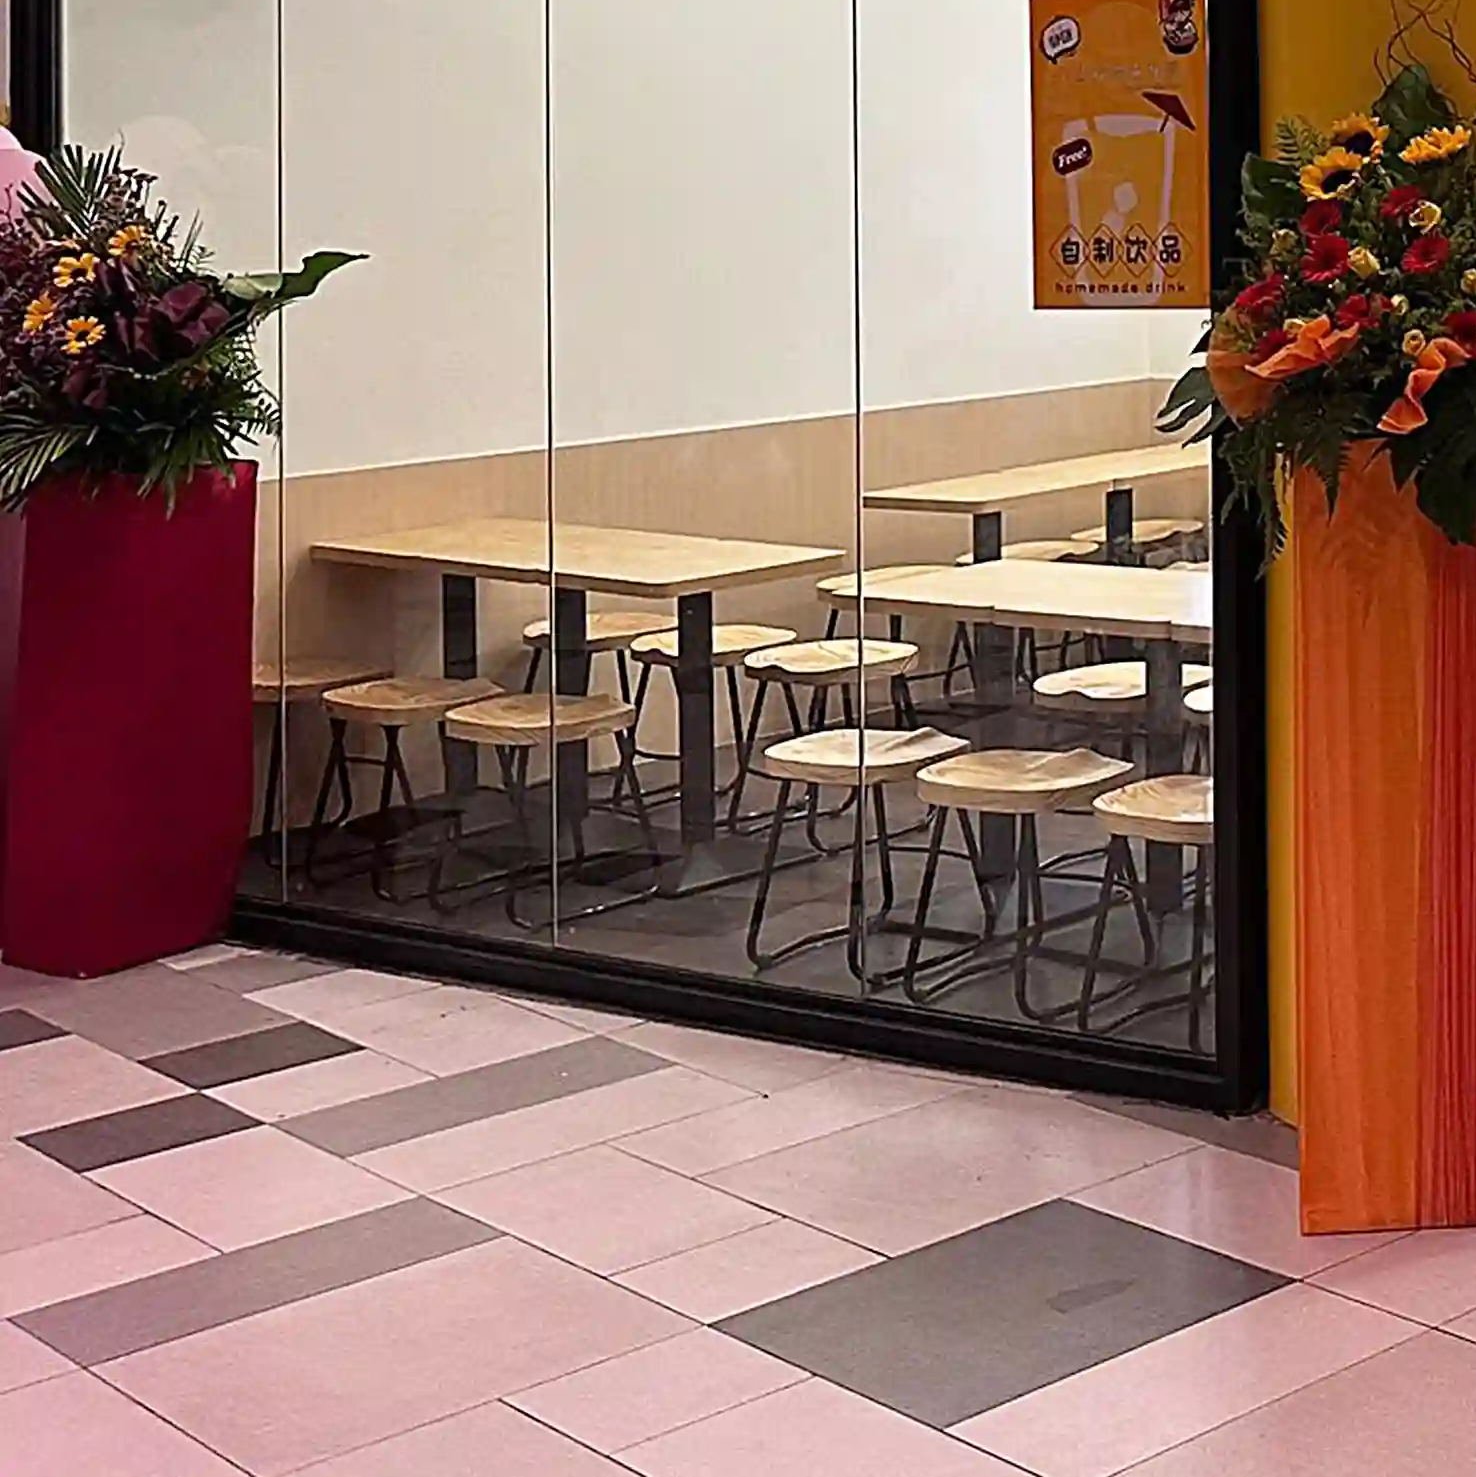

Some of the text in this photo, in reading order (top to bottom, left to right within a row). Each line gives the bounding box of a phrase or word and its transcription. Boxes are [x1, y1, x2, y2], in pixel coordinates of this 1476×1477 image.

[1060, 234, 1182, 266] 自制饮品
[1054, 281, 1187, 295] homemade drink
